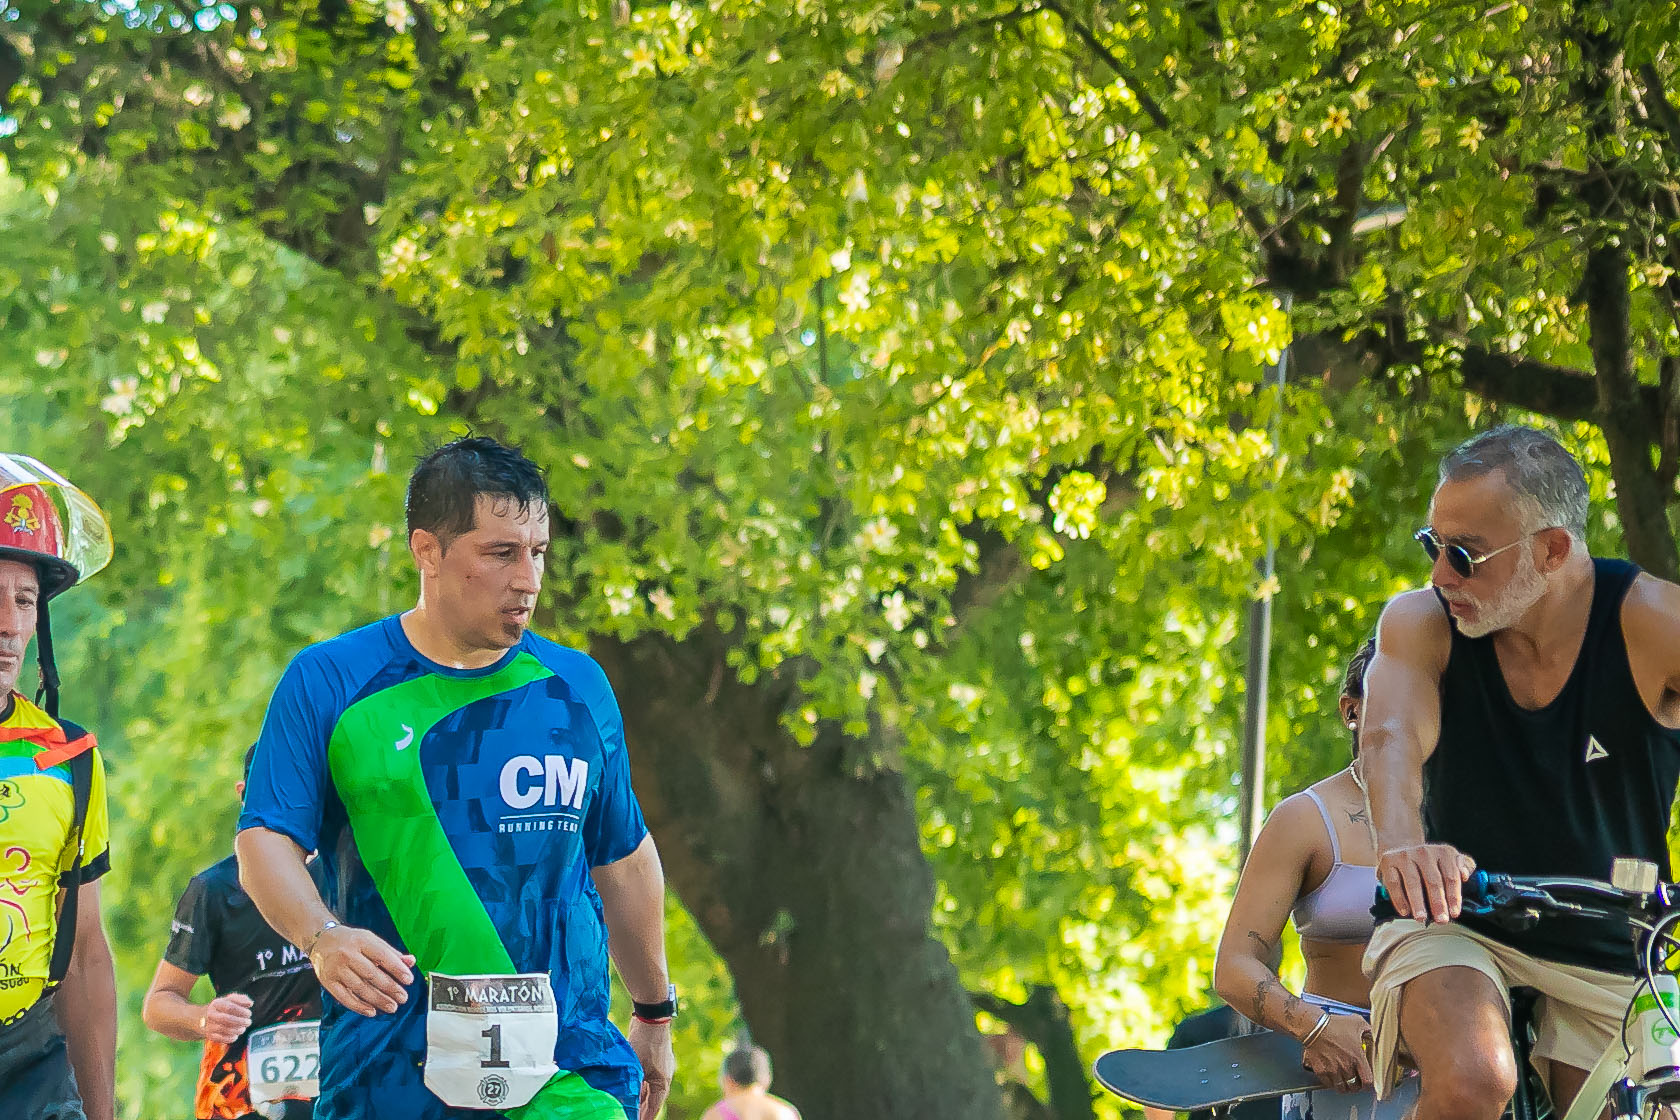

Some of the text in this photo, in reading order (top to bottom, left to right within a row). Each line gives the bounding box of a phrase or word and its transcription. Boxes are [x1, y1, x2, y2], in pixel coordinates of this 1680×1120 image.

[500, 755, 589, 809] CM
[499, 820, 554, 833] RUNNING
[464, 981, 542, 1003] MARATÓN
[481, 1024, 510, 1068] 1
[261, 1053, 319, 1083] 622
[487, 1083, 502, 1096] 27
